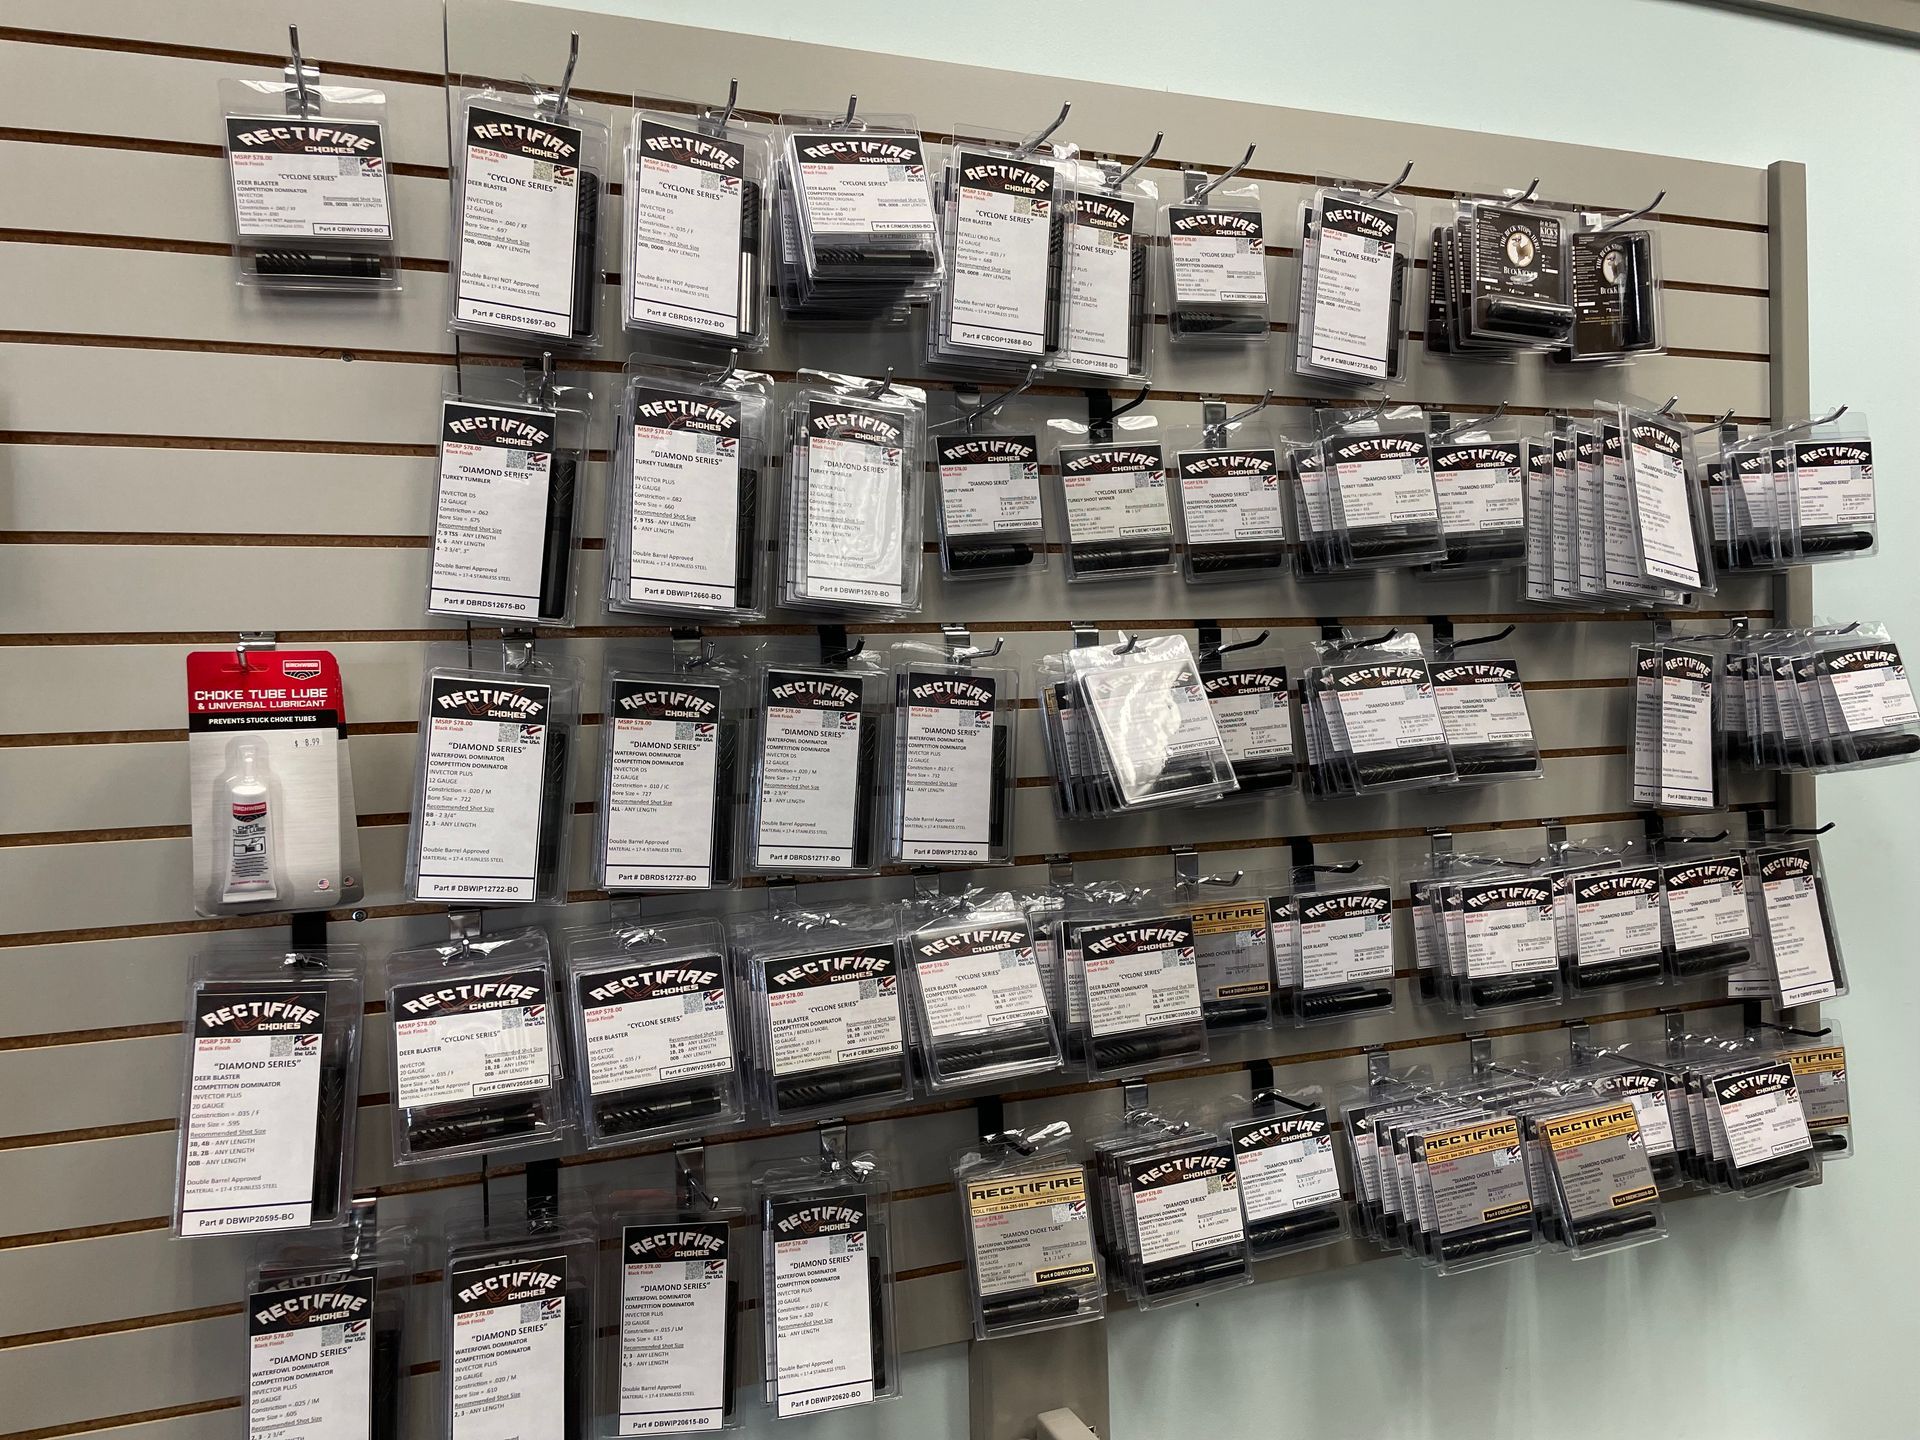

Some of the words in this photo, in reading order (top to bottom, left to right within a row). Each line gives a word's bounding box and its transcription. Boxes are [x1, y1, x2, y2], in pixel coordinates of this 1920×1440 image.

[236, 127, 376, 150] RECTIFIRE
[473, 123, 576, 158] RECTIFIRE
[305, 146, 355, 154] CHOKES
[522, 146, 559, 160] CHOKES
[646, 137, 740, 169] RECTIFIRE
[803, 141, 916, 161] RECTIFIRE
[691, 157, 725, 171] CHOKES
[964, 167, 1050, 193] RECTIFIRE
[1004, 184, 1036, 194] CHOKES
[1175, 214, 1259, 233] RECTIFIRE
[1326, 209, 1394, 235] RECTIFIRE
[1357, 226, 1383, 238] CHOKES
[472, 309, 487, 317] Part
[647, 308, 660, 316] Part
[962, 332, 974, 340] Part
[639, 400, 737, 428] RECTIFIRE
[449, 417, 549, 444] RECTIFIRE
[686, 421, 722, 431] CHOKES
[813, 413, 900, 439] RECTIFIRE
[496, 436, 533, 446] CHOKES
[855, 433, 887, 442] CHOKES
[1632, 425, 1680, 453] RECTIFIRE
[943, 441, 1034, 460] RECTIFIRE
[1339, 439, 1424, 458] RECTIFIRE
[1437, 449, 1516, 467] RECTIFIRE
[1800, 447, 1870, 463] RECTIFIRE
[1066, 452, 1160, 471] RECTIFIRE
[1185, 456, 1272, 474] RECTIFIRE
[444, 598, 459, 606] Part
[1665, 655, 1711, 677] RECTIFIRE
[1830, 651, 1897, 670] RECTIFIRE
[1338, 667, 1424, 686] RECTIFIRE
[1435, 665, 1515, 682] RECTIFIRE
[194, 690, 244, 701] CHOKE
[249, 689, 286, 700] TUBE
[291, 688, 328, 698] LUBE
[772, 681, 858, 704] RECTIFIRE
[912, 681, 992, 703] RECTIFIRE
[208, 701, 266, 710] UNIVERSAL
[270, 700, 326, 708] LUBRICANT
[438, 689, 543, 715] RECTIFIRE
[620, 692, 716, 715] RECTIFIRE
[813, 699, 844, 707] CHOKES
[208, 717, 244, 725] PREVENTS
[488, 710, 526, 719] CHOKES
[665, 709, 700, 717] CHOKES
[294, 739, 298, 748] $
[305, 737, 320, 747] 8.99
[429, 760, 471, 770] COMPETITION
[431, 752, 467, 761] WATERFOWL
[469, 754, 504, 762] DOMINATOR
[1669, 866, 1739, 885] RECTIFIRE
[1762, 857, 1810, 876] RECTIFIRE
[434, 884, 449, 892] Part
[1467, 887, 1550, 907] RECTIFIRE
[1579, 877, 1656, 898] RECTIFIRE
[1304, 897, 1387, 918] RECTIFIRE
[919, 930, 1025, 956] RECTIFIRE
[972, 943, 1011, 953] CHOKES
[1088, 928, 1189, 955] RECTIFIRE
[1137, 941, 1175, 952] CHOKES
[773, 957, 891, 985] RECTIFIRE
[830, 970, 874, 982] CHOKES
[589, 969, 718, 1000] RECTIFIRE
[652, 984, 699, 996] CHOKES
[402, 984, 540, 1014] RECTIFIRE
[469, 999, 519, 1011] CHOKES
[201, 1002, 320, 1028] RECTIFIRE
[258, 1022, 301, 1031] CHOKES
[415, 1046, 442, 1055] BLASTER
[1721, 1073, 1791, 1099] RECTIFIRE
[1549, 1110, 1634, 1136] RECTIFIRE
[1238, 1120, 1325, 1147] RECTIFIRE
[1281, 1132, 1313, 1143] CHOKES
[1426, 1124, 1516, 1149] RECTIFIRE
[1136, 1156, 1231, 1185] RECTIFIRE
[1183, 1168, 1217, 1180] CHOKES
[972, 1177, 1082, 1200] RECTIFIRE
[778, 1206, 864, 1232] RECTIFIRE
[819, 1223, 850, 1232] CHOKES
[629, 1232, 725, 1256] RECTIFIRE
[458, 1272, 562, 1303] RECTIFIRE
[508, 1289, 546, 1300] CHOKES
[255, 1293, 367, 1324] RECTIFIRE
[309, 1311, 350, 1323] CHOKES
[455, 1344, 491, 1355] WATERFOWL
[493, 1338, 528, 1348] DOMINATOR
